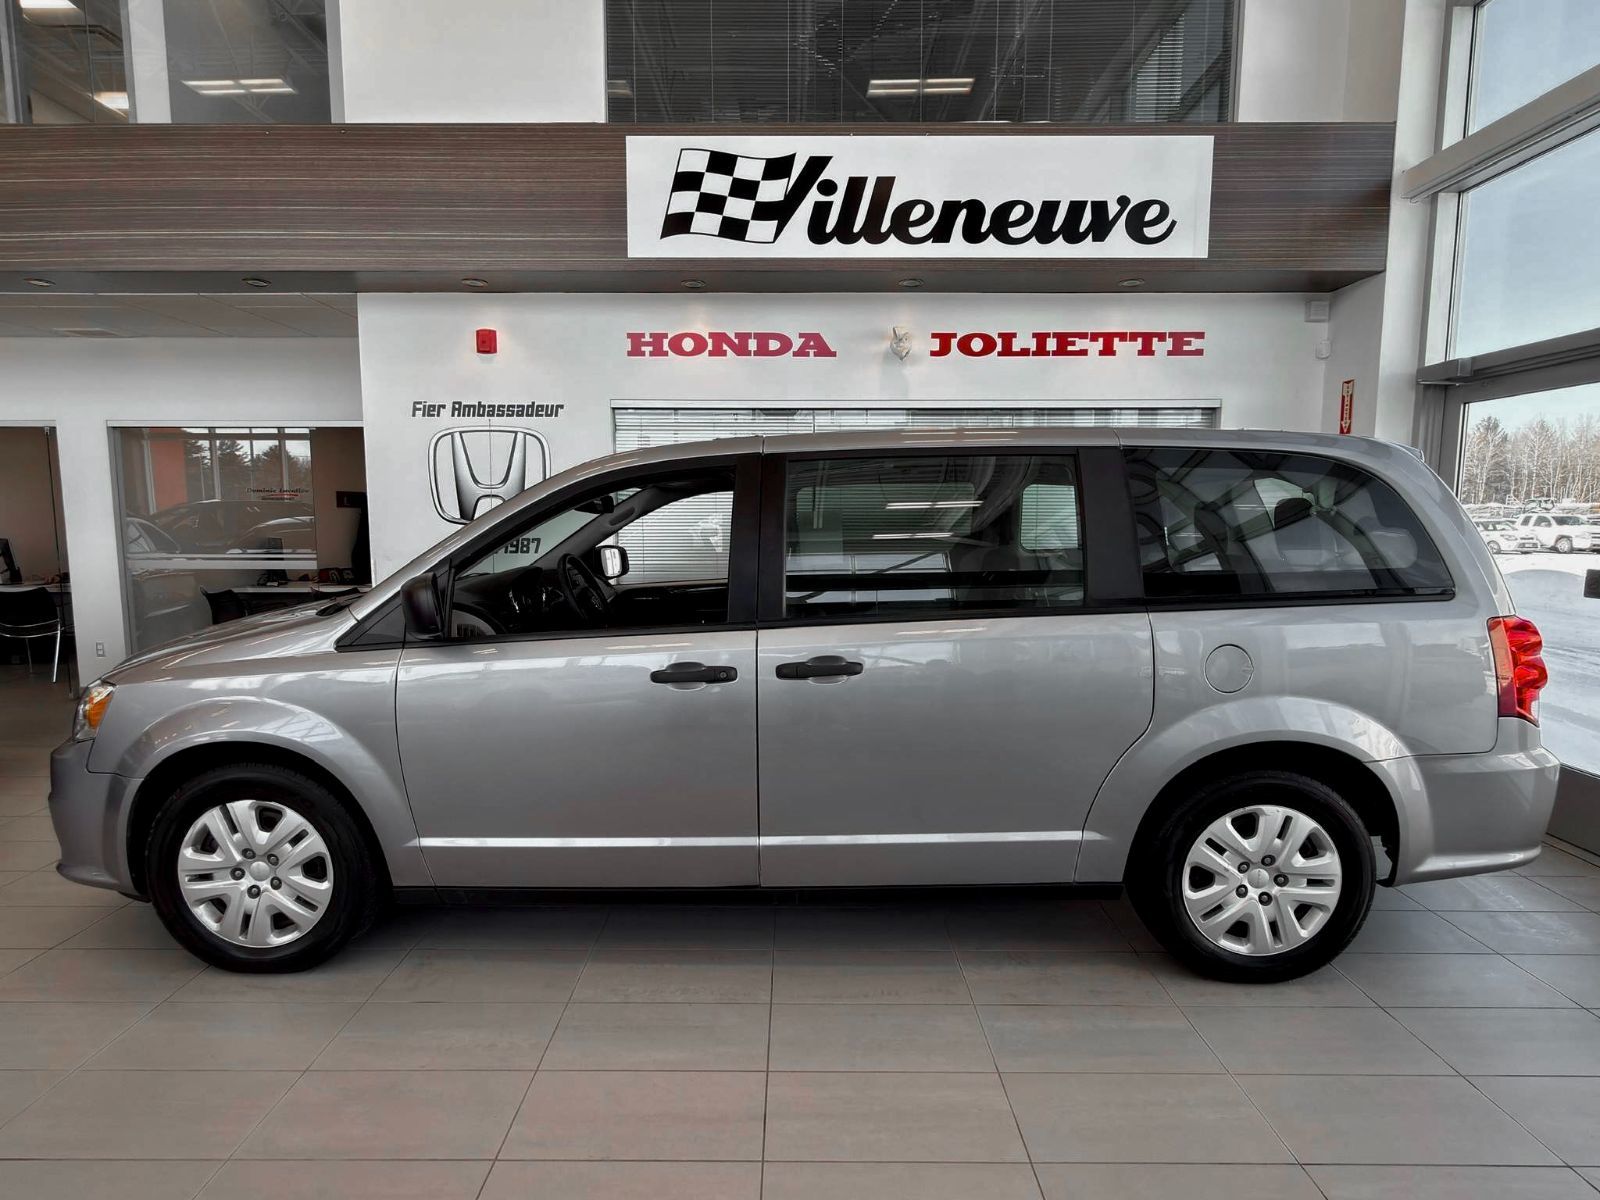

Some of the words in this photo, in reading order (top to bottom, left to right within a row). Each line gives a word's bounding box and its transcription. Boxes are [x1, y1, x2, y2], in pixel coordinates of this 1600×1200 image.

[757, 153, 1177, 245] Villeneuve
[626, 332, 837, 357] HONDA
[930, 331, 1205, 357] JOLIETTE
[411, 401, 446, 418] Fier
[451, 401, 564, 418] Ambassadeur
